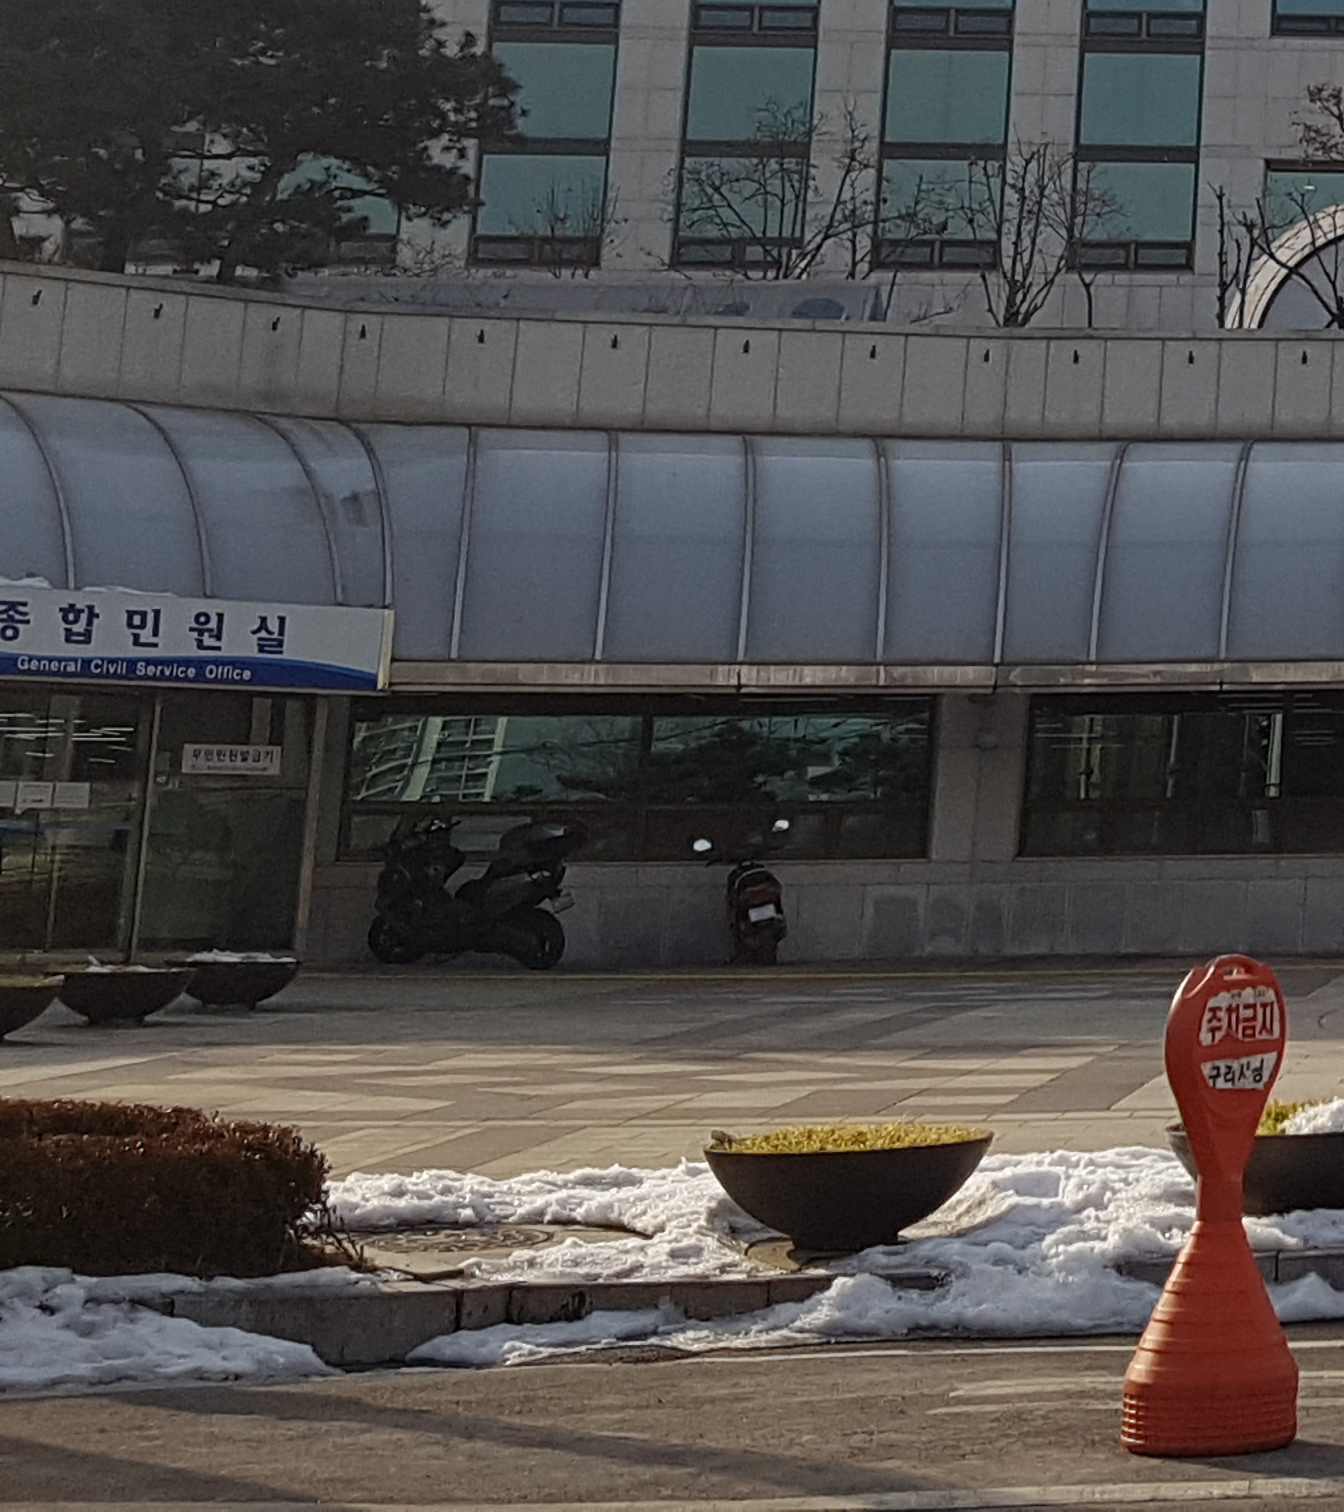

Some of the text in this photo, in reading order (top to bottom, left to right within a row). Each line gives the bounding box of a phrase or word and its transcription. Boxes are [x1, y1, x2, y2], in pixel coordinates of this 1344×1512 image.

[17, 656, 252, 681] General Civil Service Office
[1206, 1001, 1275, 1044] 주차금지
